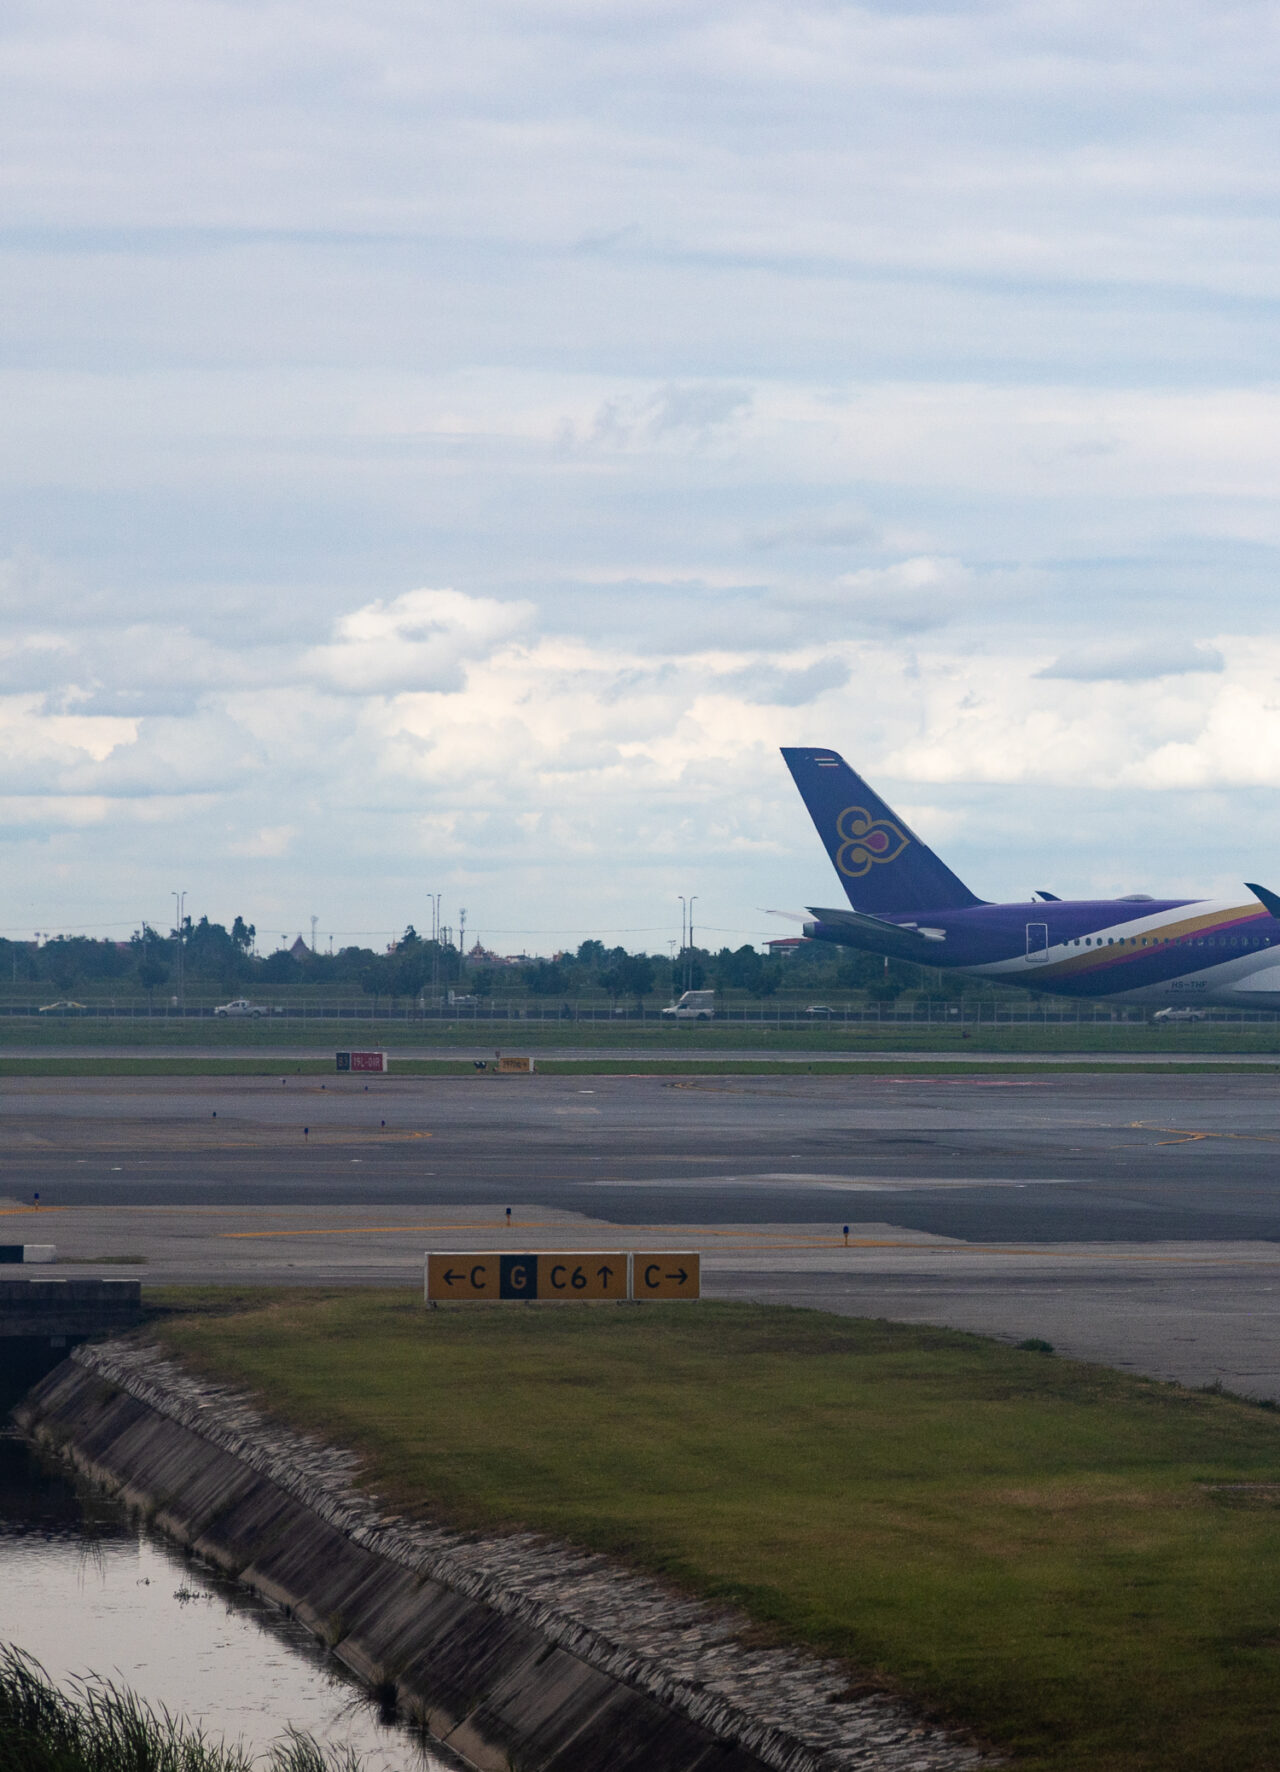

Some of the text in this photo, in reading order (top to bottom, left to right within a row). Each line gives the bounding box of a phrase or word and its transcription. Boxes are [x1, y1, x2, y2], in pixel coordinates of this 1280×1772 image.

[470, 1265, 588, 1290] C G C6
[644, 1264, 661, 1289] C
